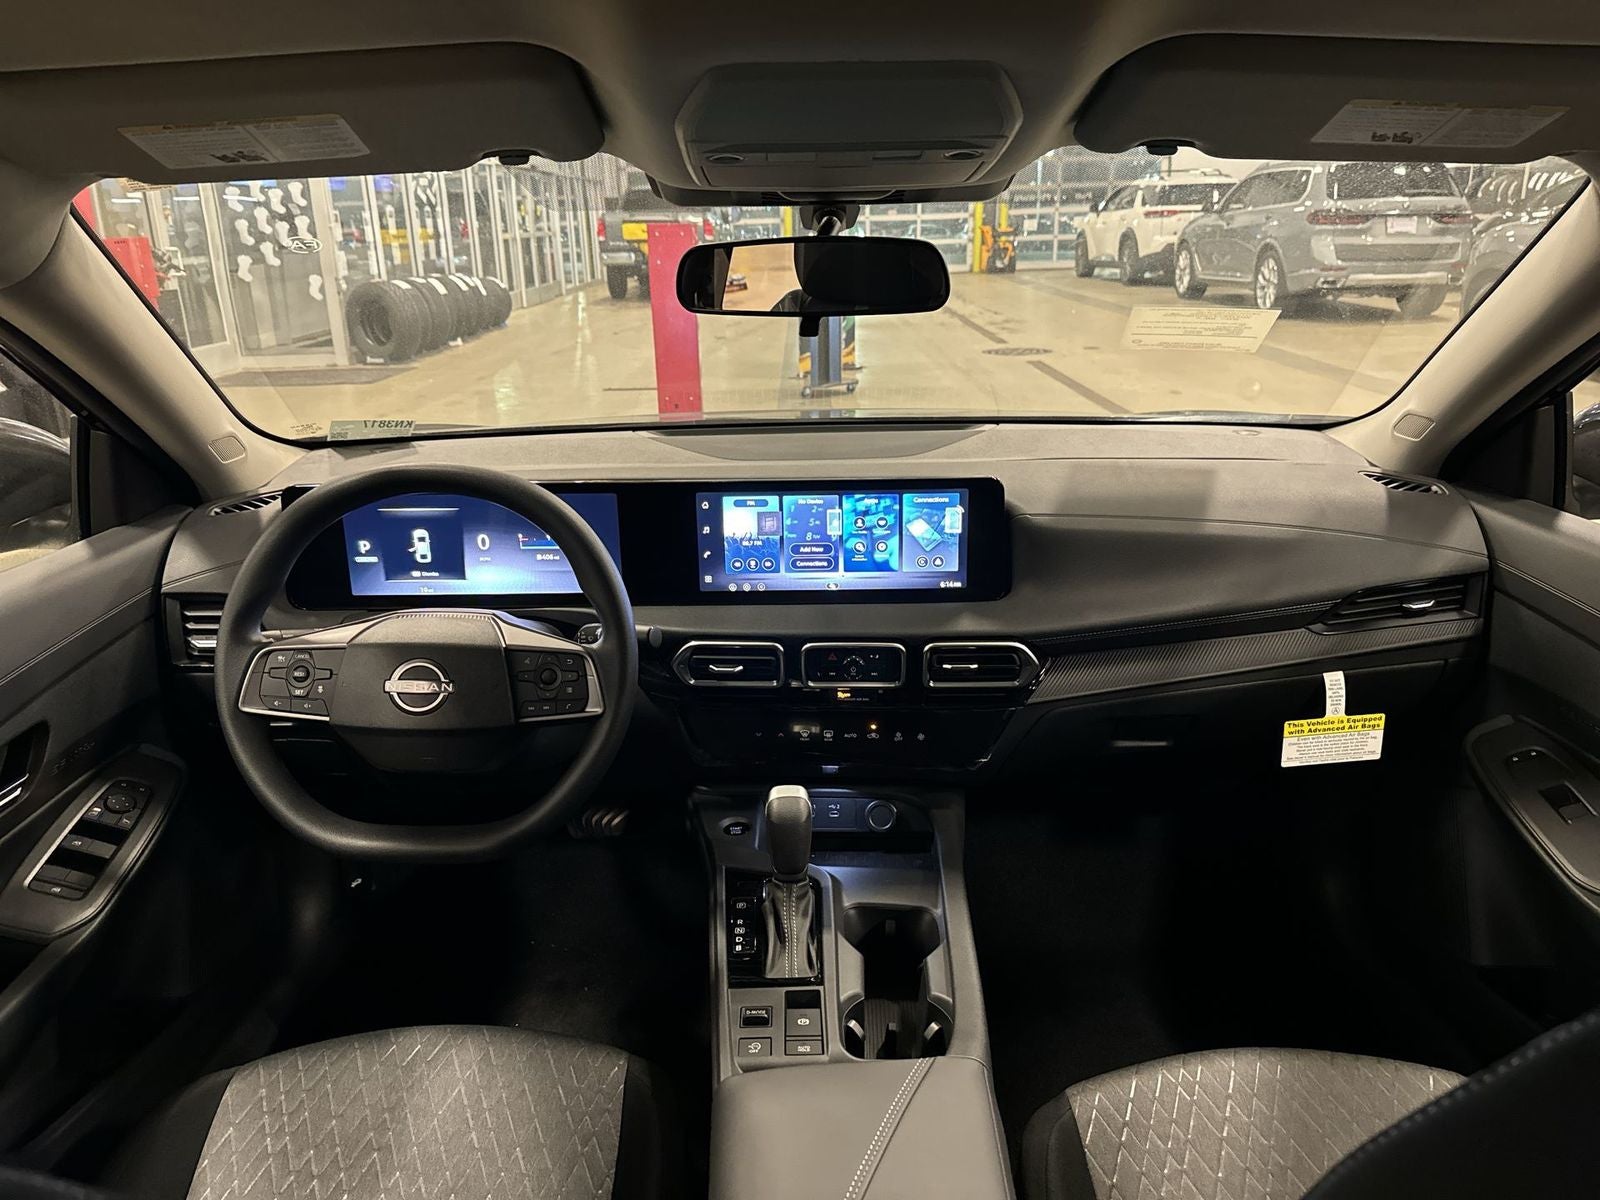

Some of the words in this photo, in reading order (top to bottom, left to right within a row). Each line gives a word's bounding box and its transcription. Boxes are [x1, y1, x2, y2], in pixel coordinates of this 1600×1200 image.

[358, 540, 371, 554] P
[477, 533, 490, 551] 0
[387, 682, 453, 692] NISSAN
[1287, 721, 1304, 729] This
[1306, 719, 1334, 728] Vehicle
[1347, 715, 1383, 724] Equipped
[1288, 728, 1305, 736] with
[1307, 725, 1346, 734] Advanced
[1348, 723, 1359, 731] Air
[1361, 722, 1381, 731] Bags
